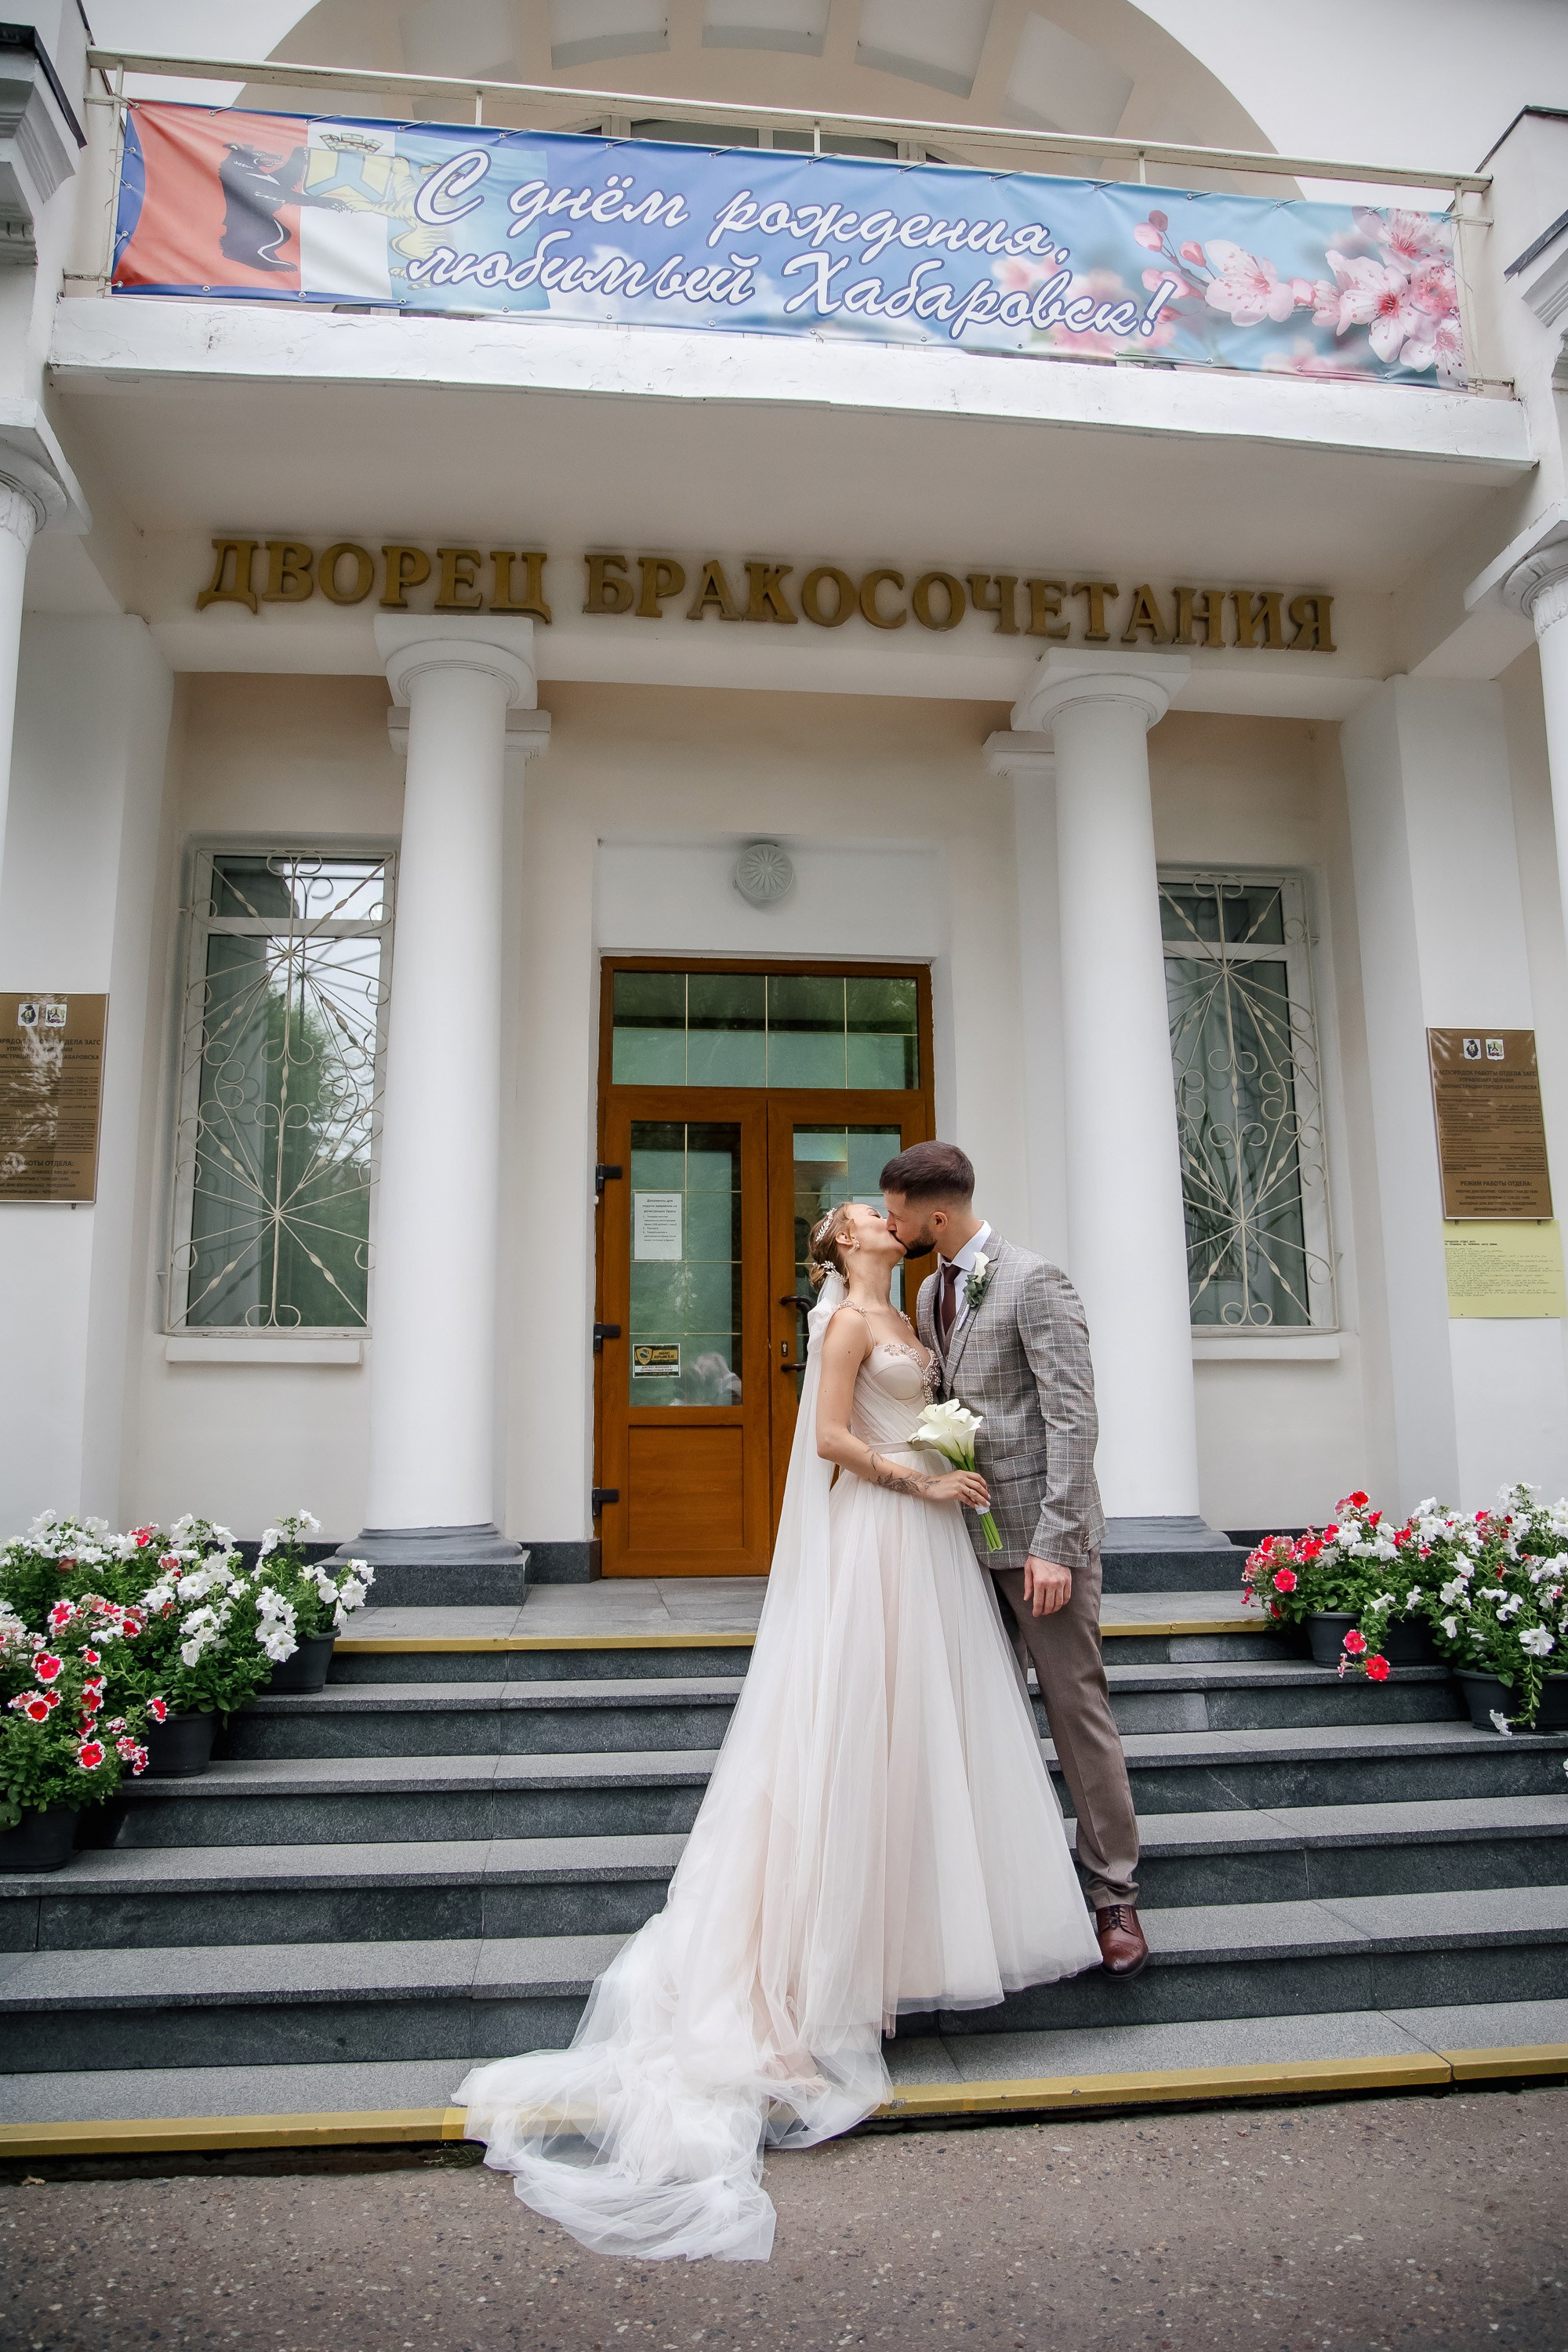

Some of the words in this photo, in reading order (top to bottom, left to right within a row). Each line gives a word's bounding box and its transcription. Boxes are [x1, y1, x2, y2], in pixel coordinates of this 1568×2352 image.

[414, 149, 492, 226] С
[506, 173, 691, 238] днём
[707, 188, 1071, 265] рождения,
[406, 230, 761, 304] любимый
[782, 251, 1178, 339] Хабаровск!
[196, 538, 552, 625] ДВОРЕЦ
[583, 553, 1338, 652] БРАКОСОЧЕТАНИЯ
